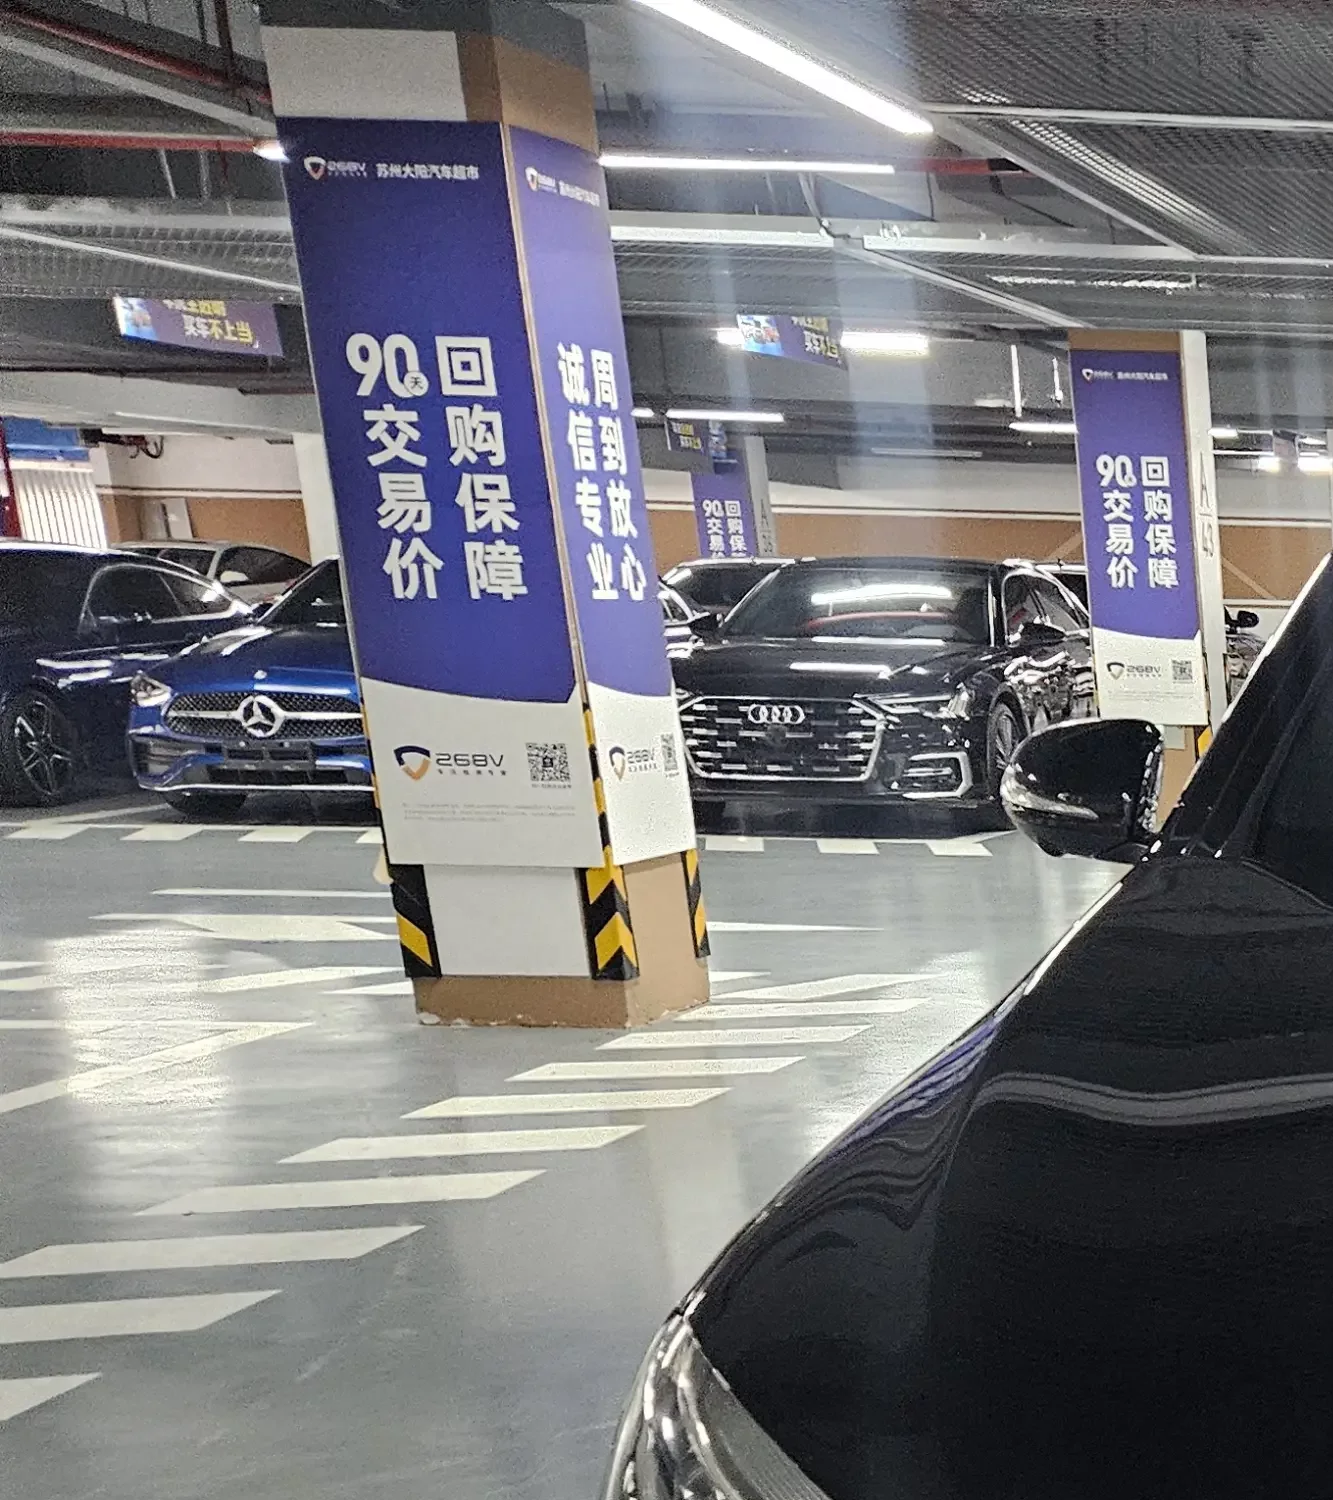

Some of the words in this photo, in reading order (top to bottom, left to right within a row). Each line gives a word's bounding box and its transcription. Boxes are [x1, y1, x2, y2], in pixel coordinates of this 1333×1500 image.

[436, 335, 528, 600] 回购保障
[556, 342, 620, 601] 诚信专业
[588, 348, 646, 601] 周到放心
[724, 499, 748, 558] 回购保
[1140, 456, 1180, 589] 回购保障
[435, 752, 504, 768] 268V
